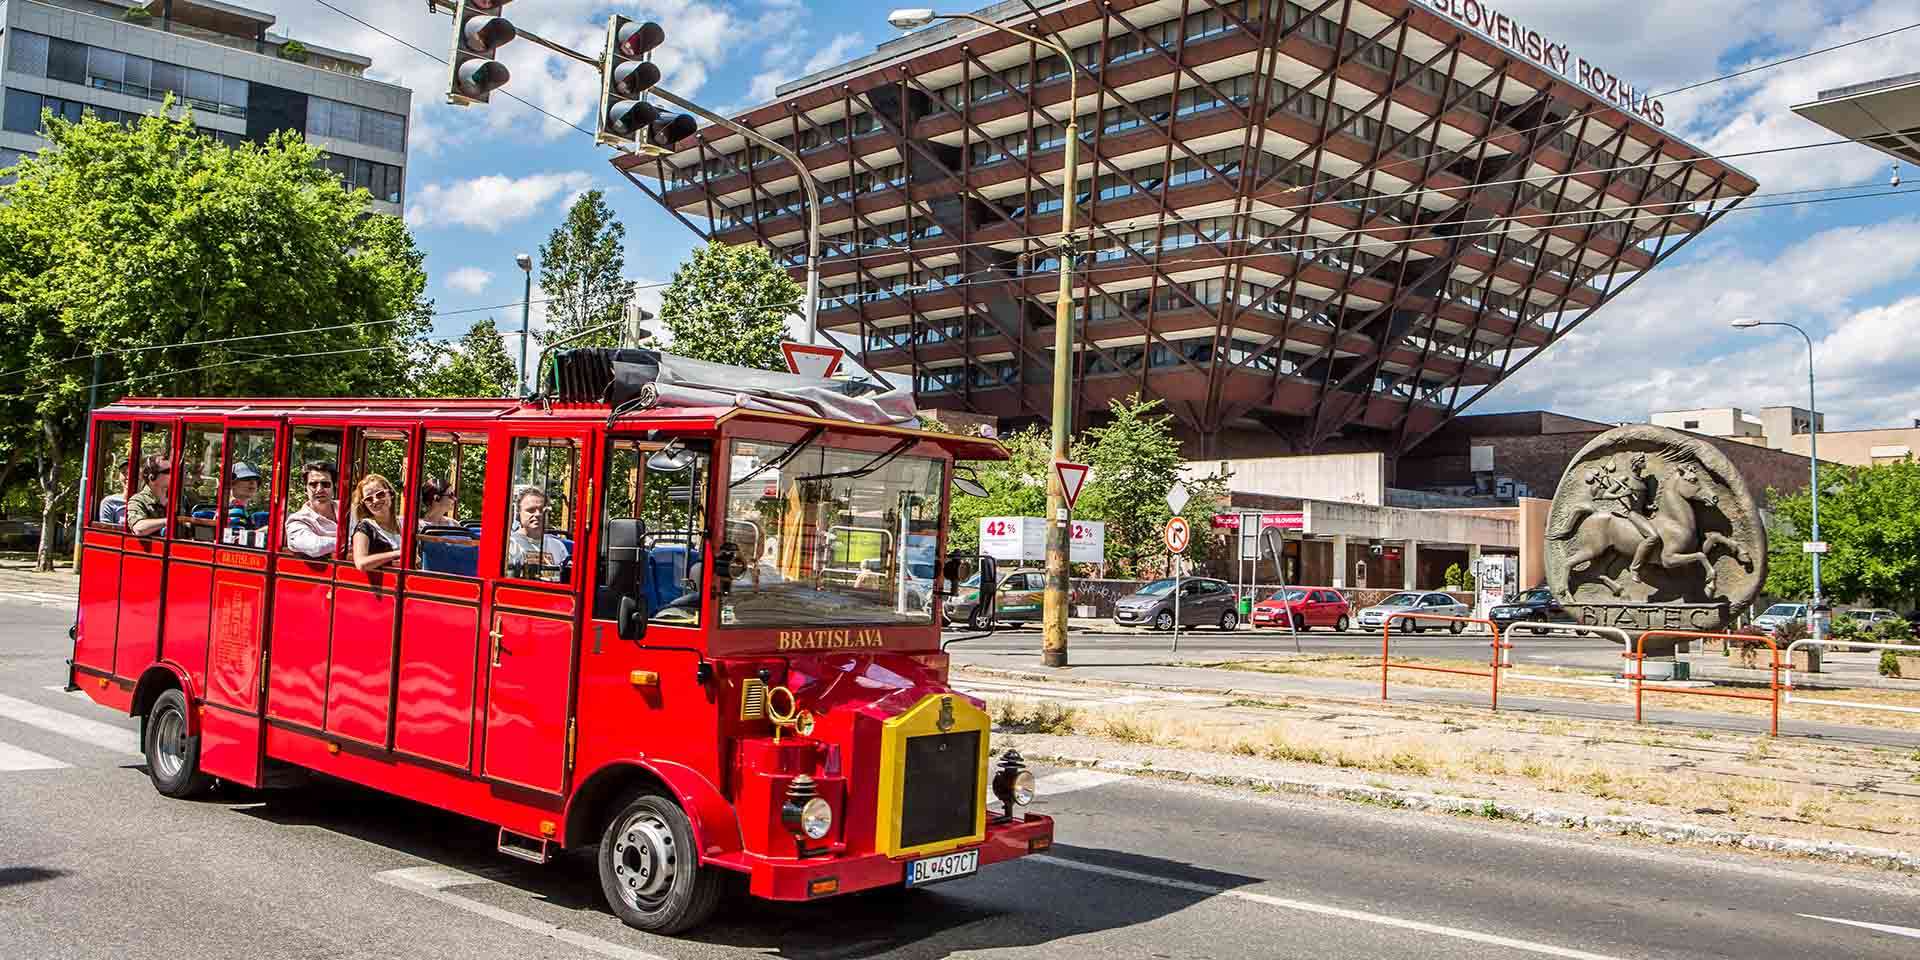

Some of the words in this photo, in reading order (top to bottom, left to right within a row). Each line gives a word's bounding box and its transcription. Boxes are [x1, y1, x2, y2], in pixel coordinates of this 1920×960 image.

[1577, 56, 1665, 127] ROZHLAS
[1582, 605, 1710, 629] BIATEC
[592, 625, 603, 655] 1
[779, 629, 883, 649] BRATISLAVA
